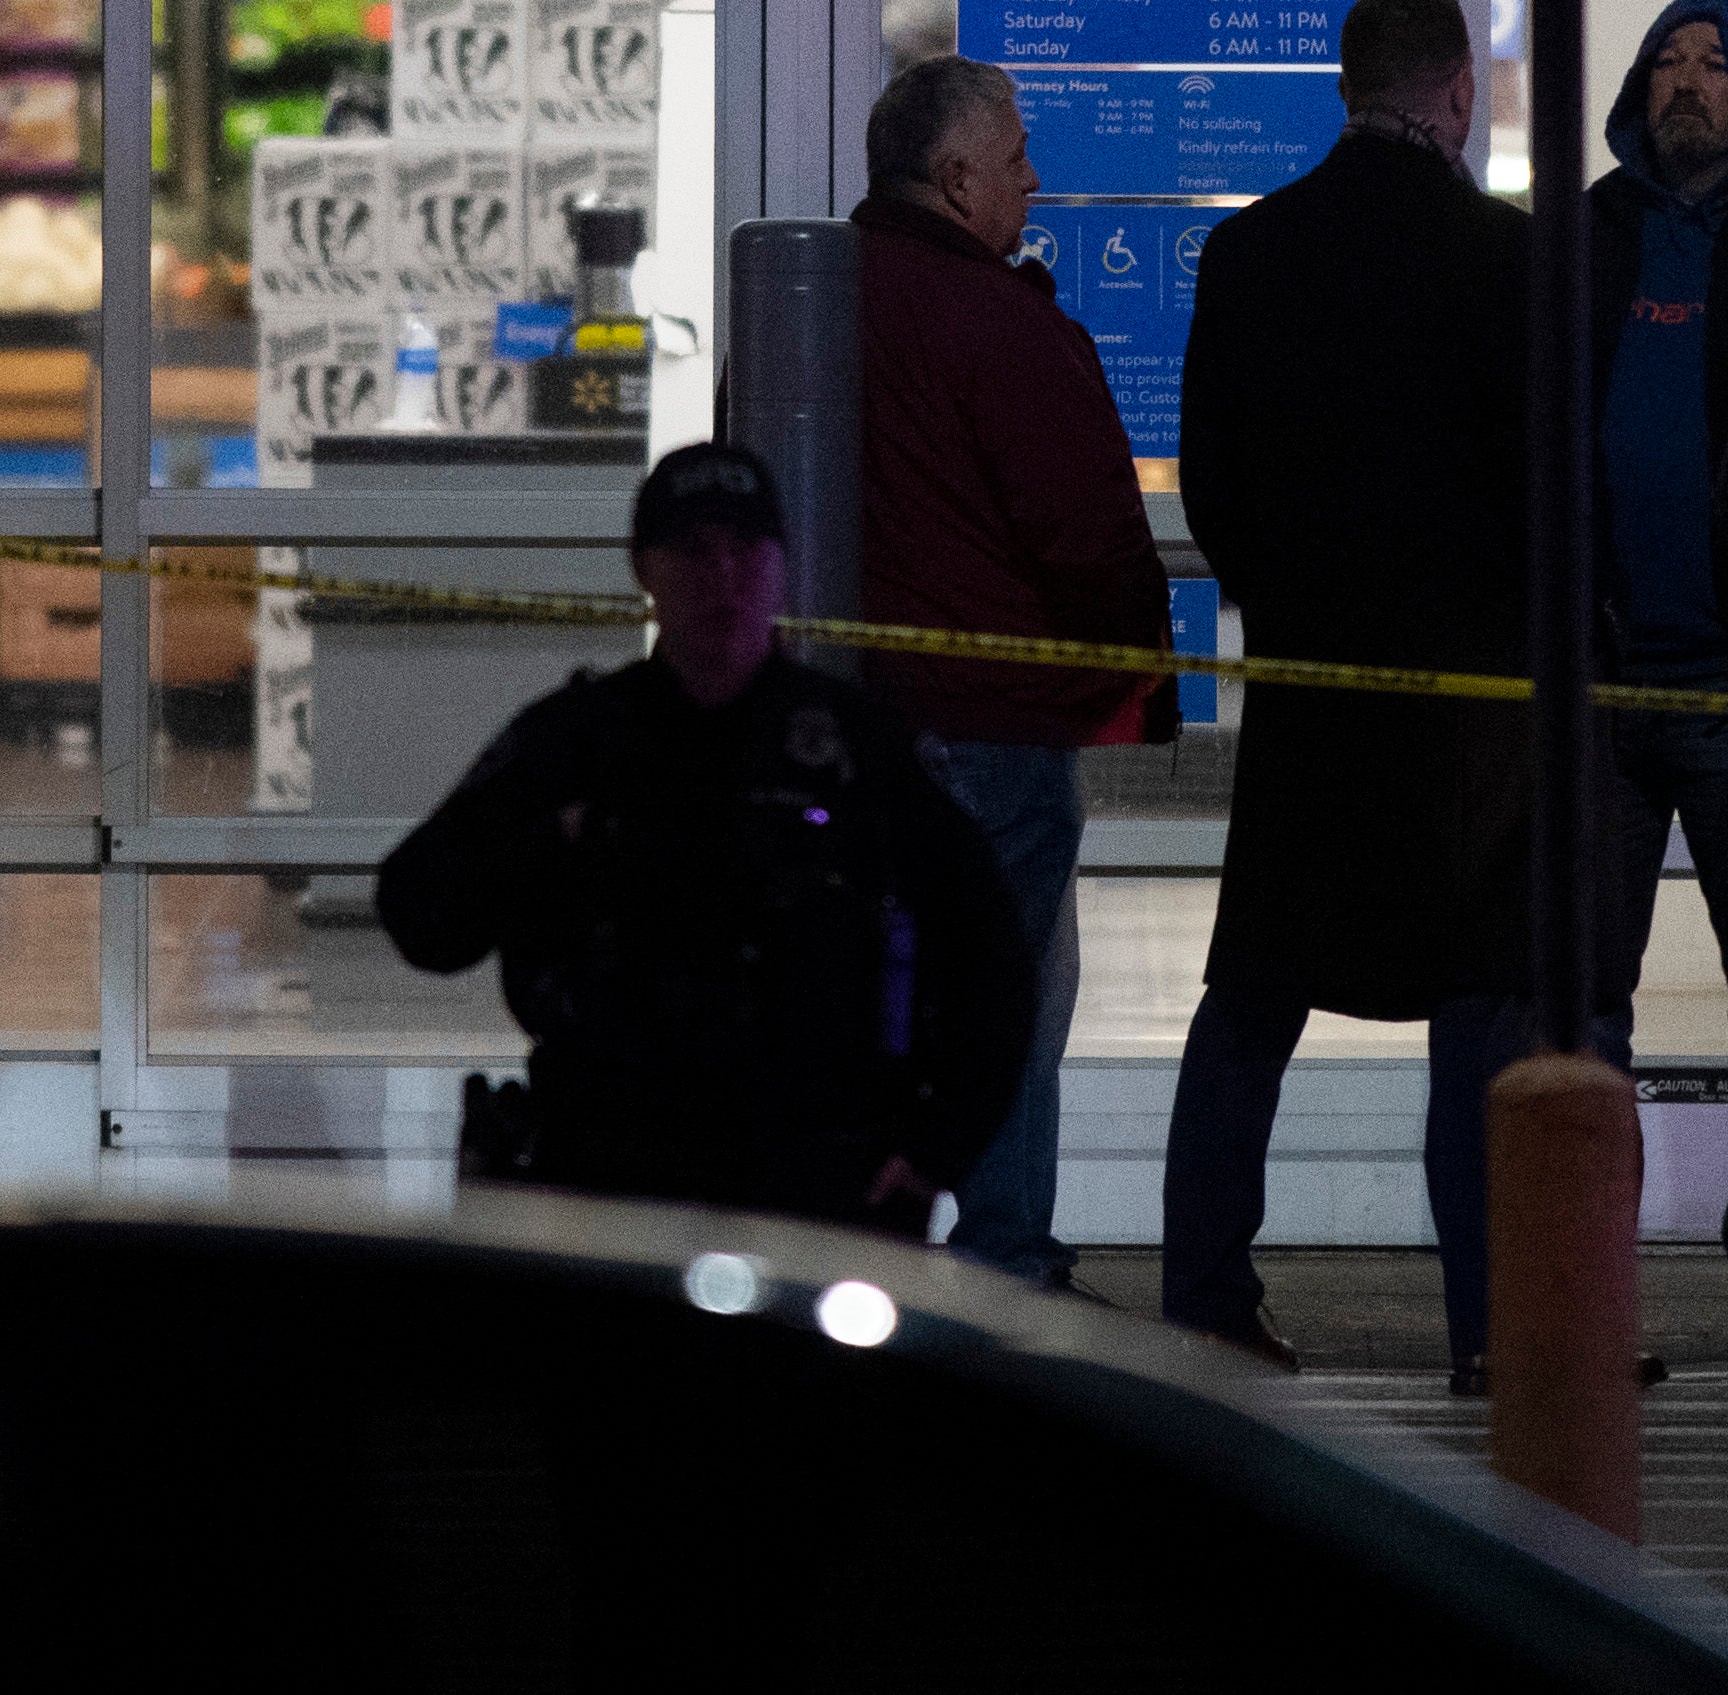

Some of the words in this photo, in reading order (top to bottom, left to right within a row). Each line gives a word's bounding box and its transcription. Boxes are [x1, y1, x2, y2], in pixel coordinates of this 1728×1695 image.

[1004, 12, 1086, 32] Saturday
[1208, 13, 1220, 29] 6
[1226, 13, 1259, 29] AM
[1278, 12, 1291, 29] 11
[1297, 12, 1328, 29] PM
[1004, 39, 1070, 59] Sunday
[1208, 39, 1220, 56] 6
[1226, 39, 1259, 56] AM
[1278, 39, 1291, 56] 11
[1297, 39, 1328, 56] PM
[1018, 81, 1065, 94] armacy
[1069, 80, 1109, 92] Hours
[1178, 117, 1199, 130] No
[1202, 117, 1262, 133] soliciting
[1178, 141, 1221, 156] Kindly
[1224, 141, 1270, 154] refrain
[1274, 141, 1308, 154] from
[1178, 176, 1229, 189] firearm
[1117, 355, 1162, 368] appear
[1118, 374, 1134, 385] to
[1136, 373, 1183, 391] provid
